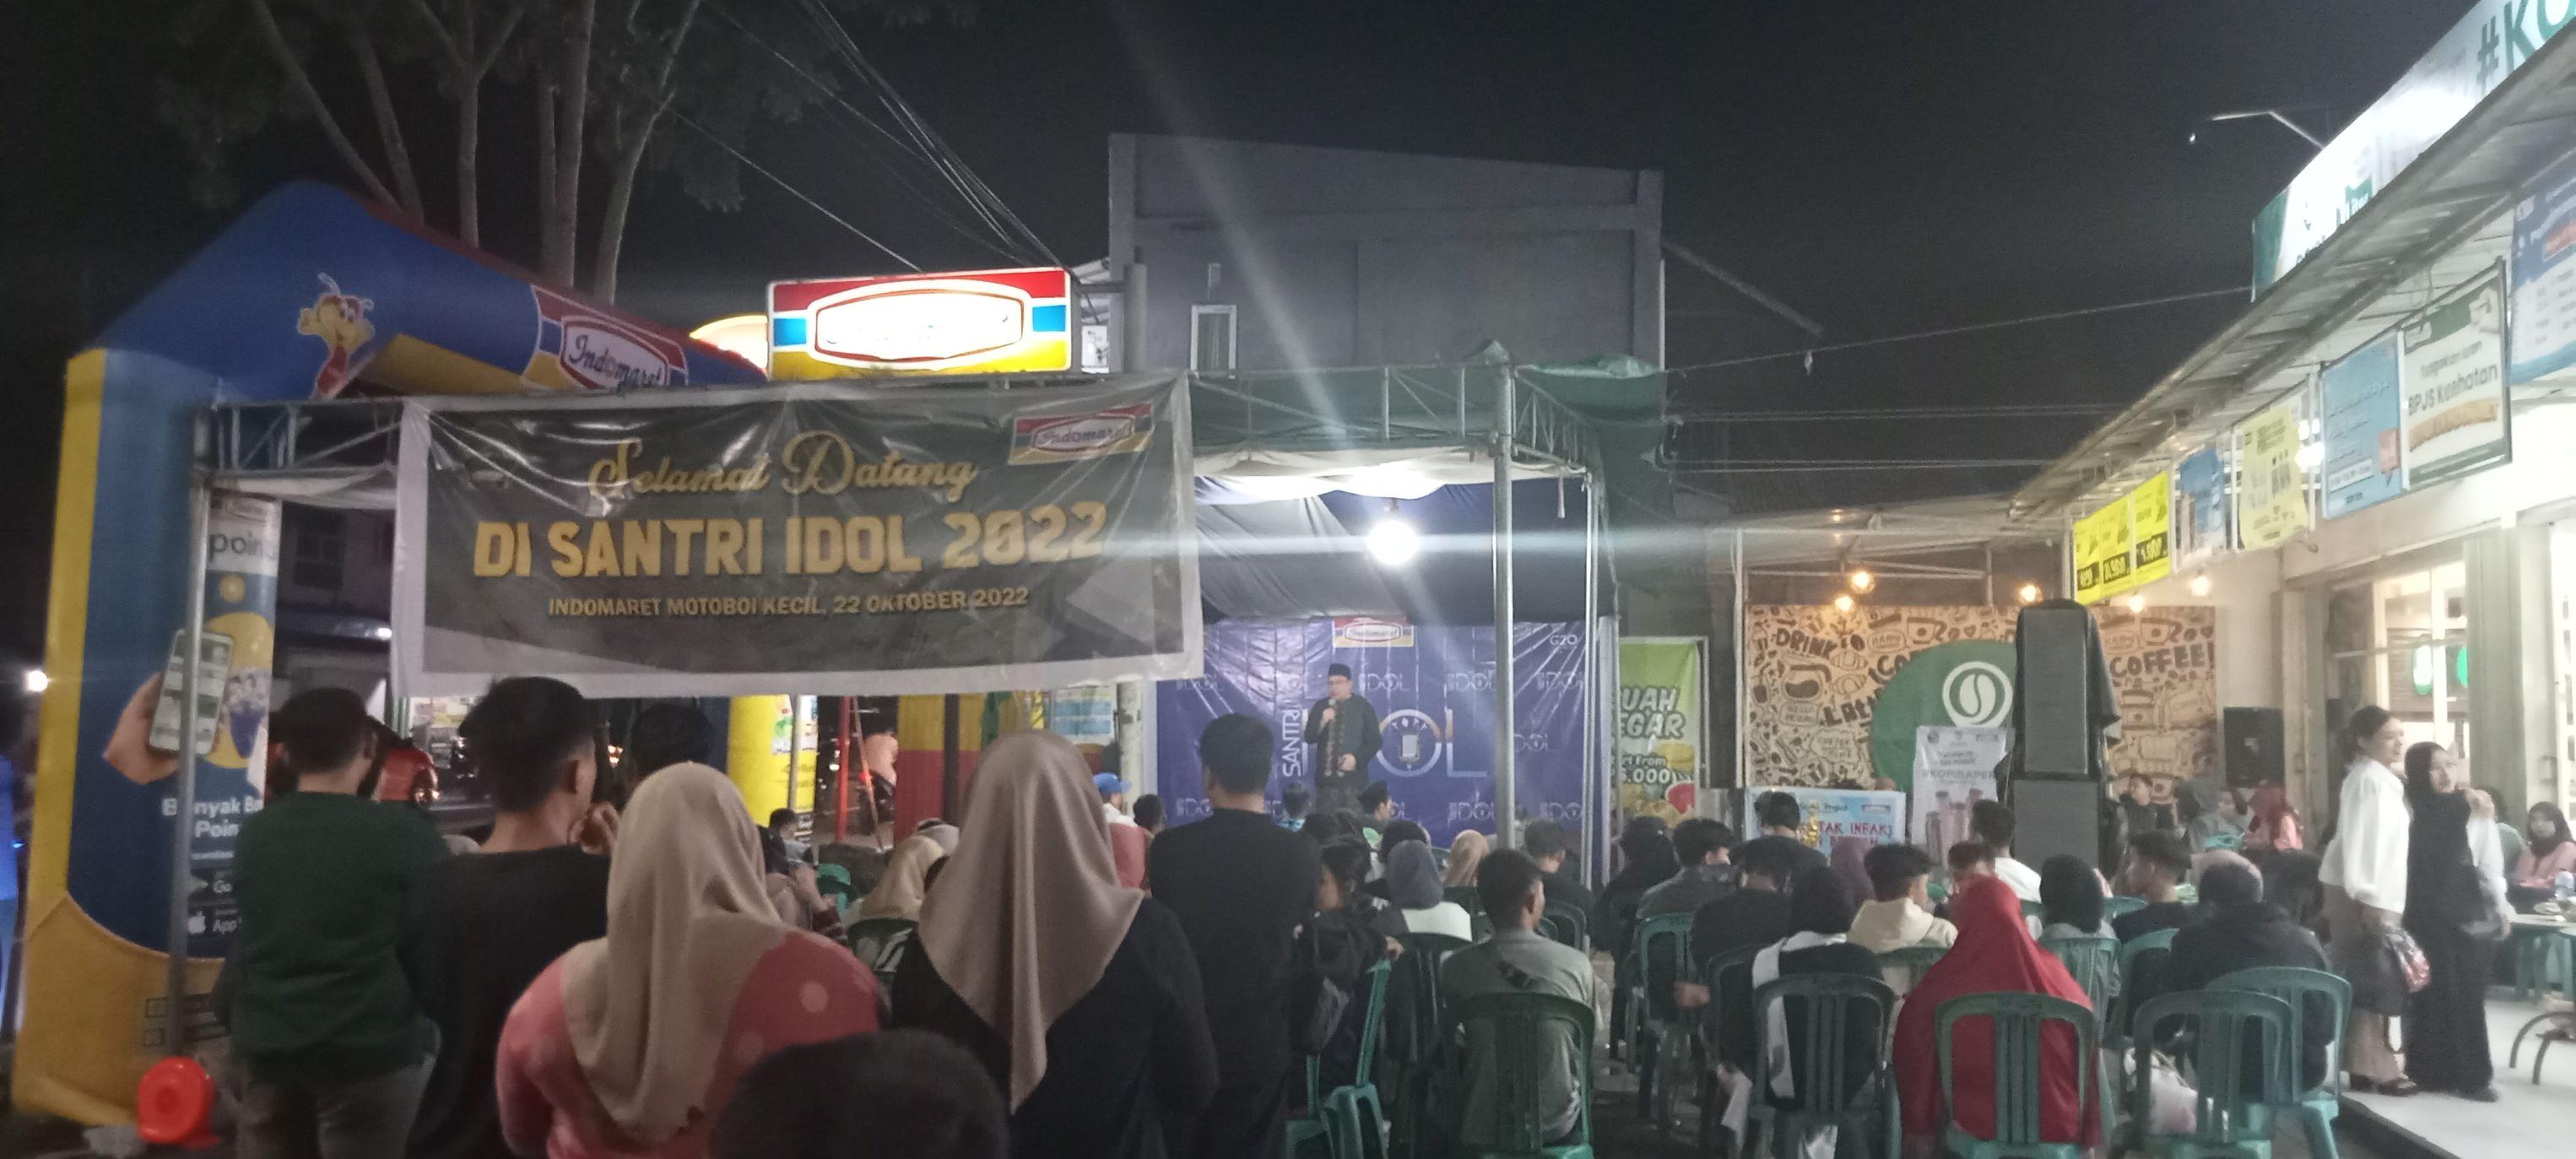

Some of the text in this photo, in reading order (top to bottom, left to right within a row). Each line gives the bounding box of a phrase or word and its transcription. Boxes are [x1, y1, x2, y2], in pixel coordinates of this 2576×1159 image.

[589, 430, 978, 502] Selamat Datang
[474, 501, 1107, 577] DI SANTRI IDOL 2022
[548, 597, 662, 616] INDOMARET
[666, 596, 758, 616] MOTOBOI
[833, 595, 860, 614] 22
[866, 589, 968, 614] OKTOBER
[974, 586, 1030, 608] 2022
[1549, 634, 1578, 647] G20
[1776, 627, 1837, 659] DRINK
[1621, 687, 1677, 712] UAH
[161, 796, 241, 820] Bnyak
